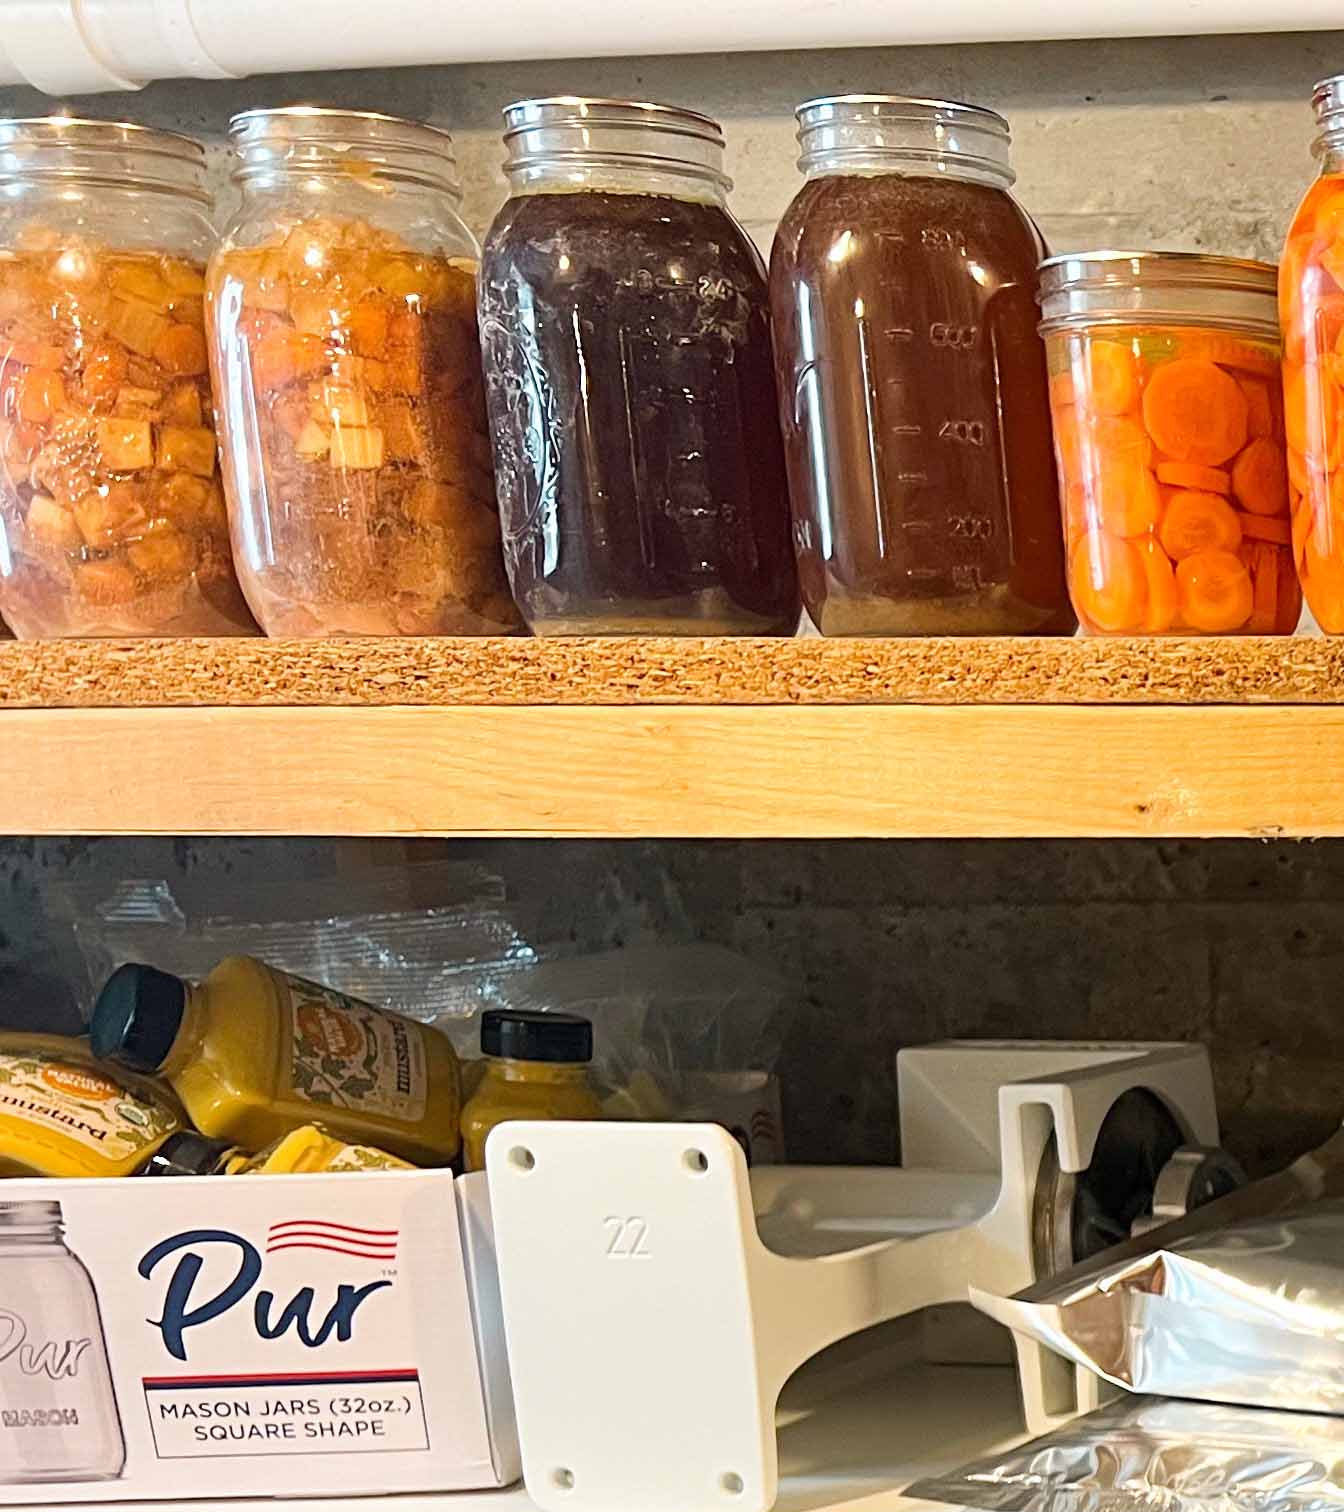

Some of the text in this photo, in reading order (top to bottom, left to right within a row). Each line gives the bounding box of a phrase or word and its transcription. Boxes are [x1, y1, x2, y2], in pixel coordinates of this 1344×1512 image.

[602, 1215, 651, 1258] 22
[138, 1229, 393, 1361] Pur
[1, 1408, 79, 1427] MASON
[160, 1396, 412, 1419] MASON JARS (32oz.)
[194, 1420, 385, 1441] SQUARE SHAPE
